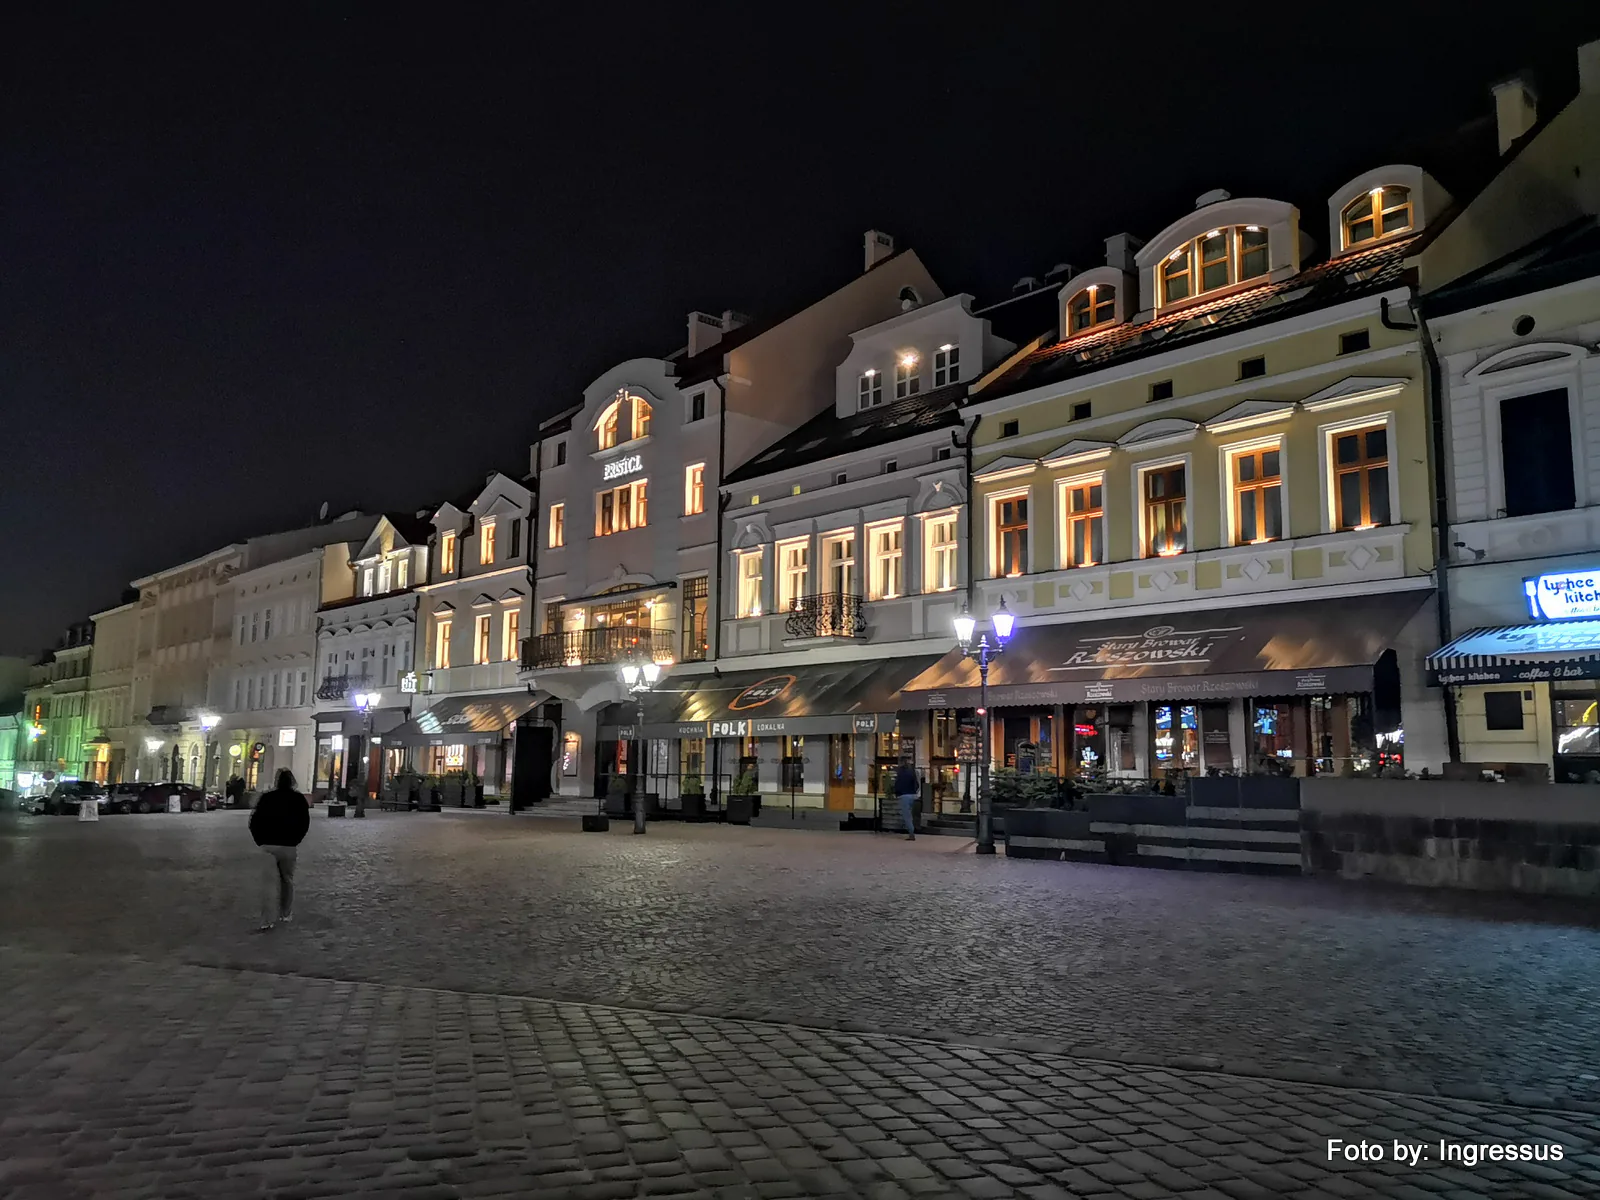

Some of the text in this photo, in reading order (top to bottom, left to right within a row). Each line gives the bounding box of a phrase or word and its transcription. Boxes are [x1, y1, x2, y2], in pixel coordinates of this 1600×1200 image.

[1543, 578, 1595, 595] lychee
[1518, 668, 1550, 682] coffee
[1563, 665, 1584, 677] bar
[712, 722, 746, 736] FOLK
